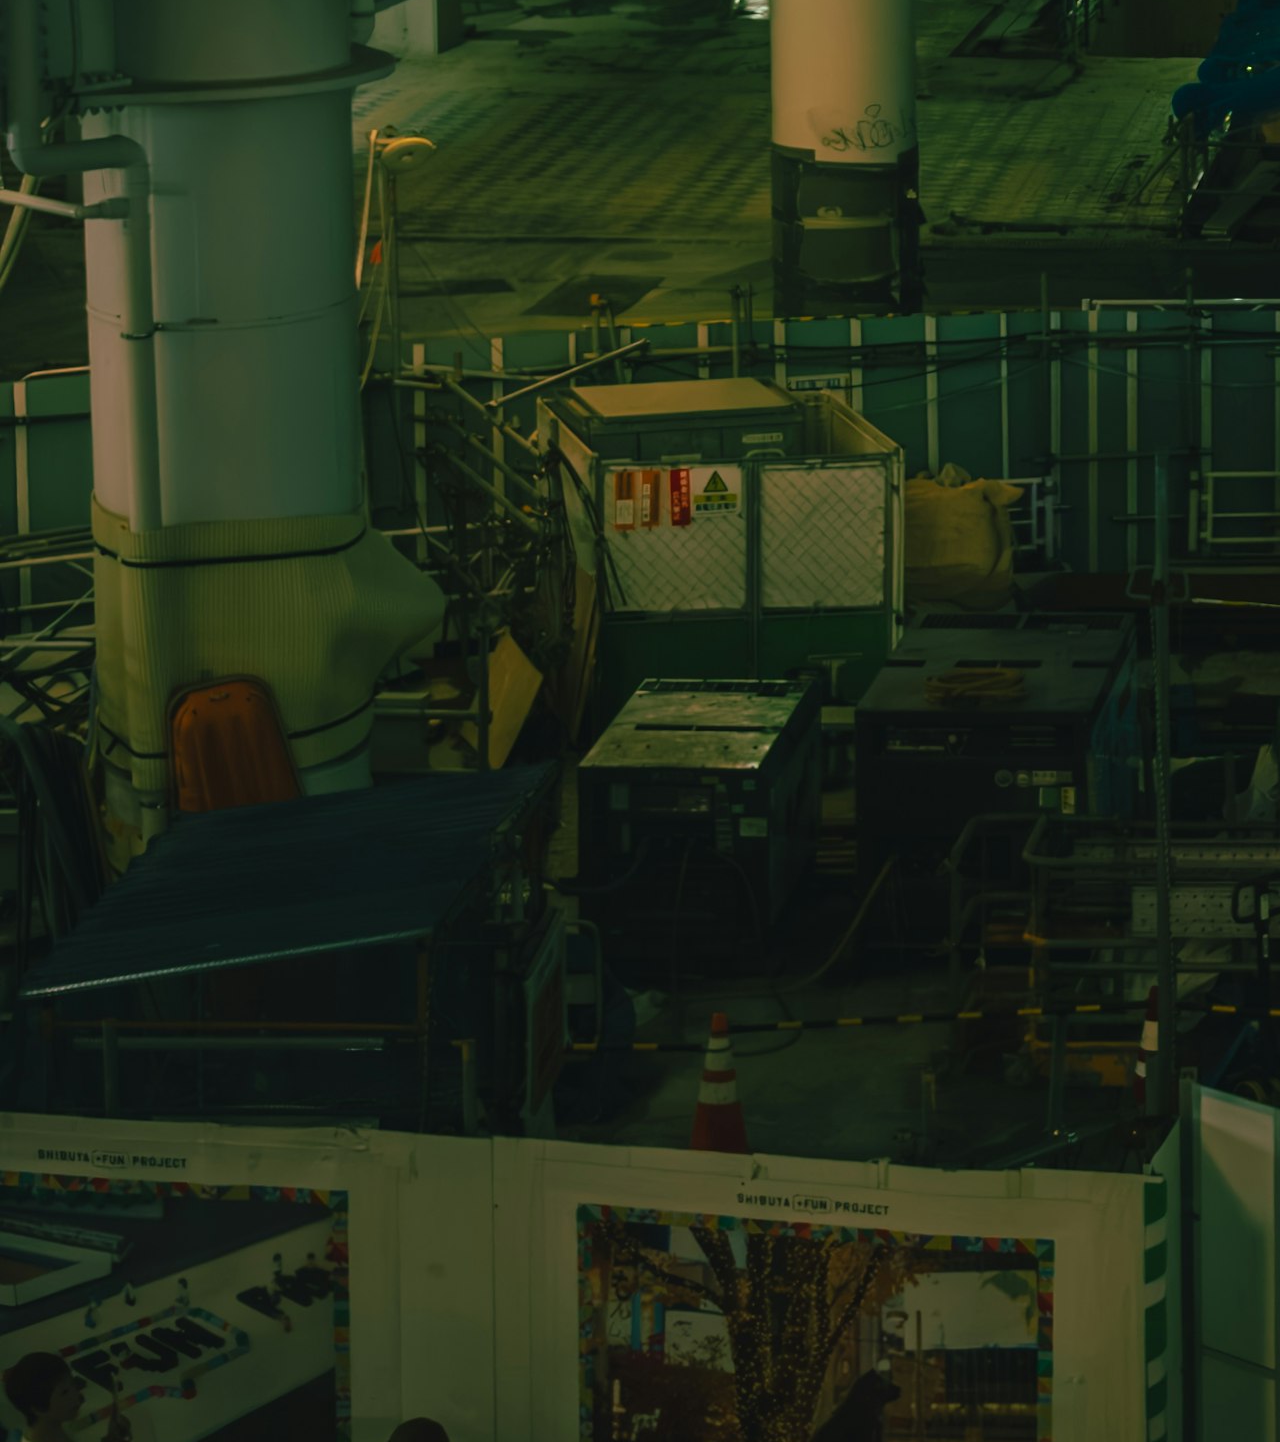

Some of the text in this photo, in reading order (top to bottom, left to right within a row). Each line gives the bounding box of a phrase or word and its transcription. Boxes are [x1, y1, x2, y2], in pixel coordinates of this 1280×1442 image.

[37, 1149, 90, 1163] SHIBUYA
[131, 1156, 187, 1169] PROJECT
[736, 1192, 790, 1208] SHIBUYA
[834, 1203, 890, 1216] PROJECT
